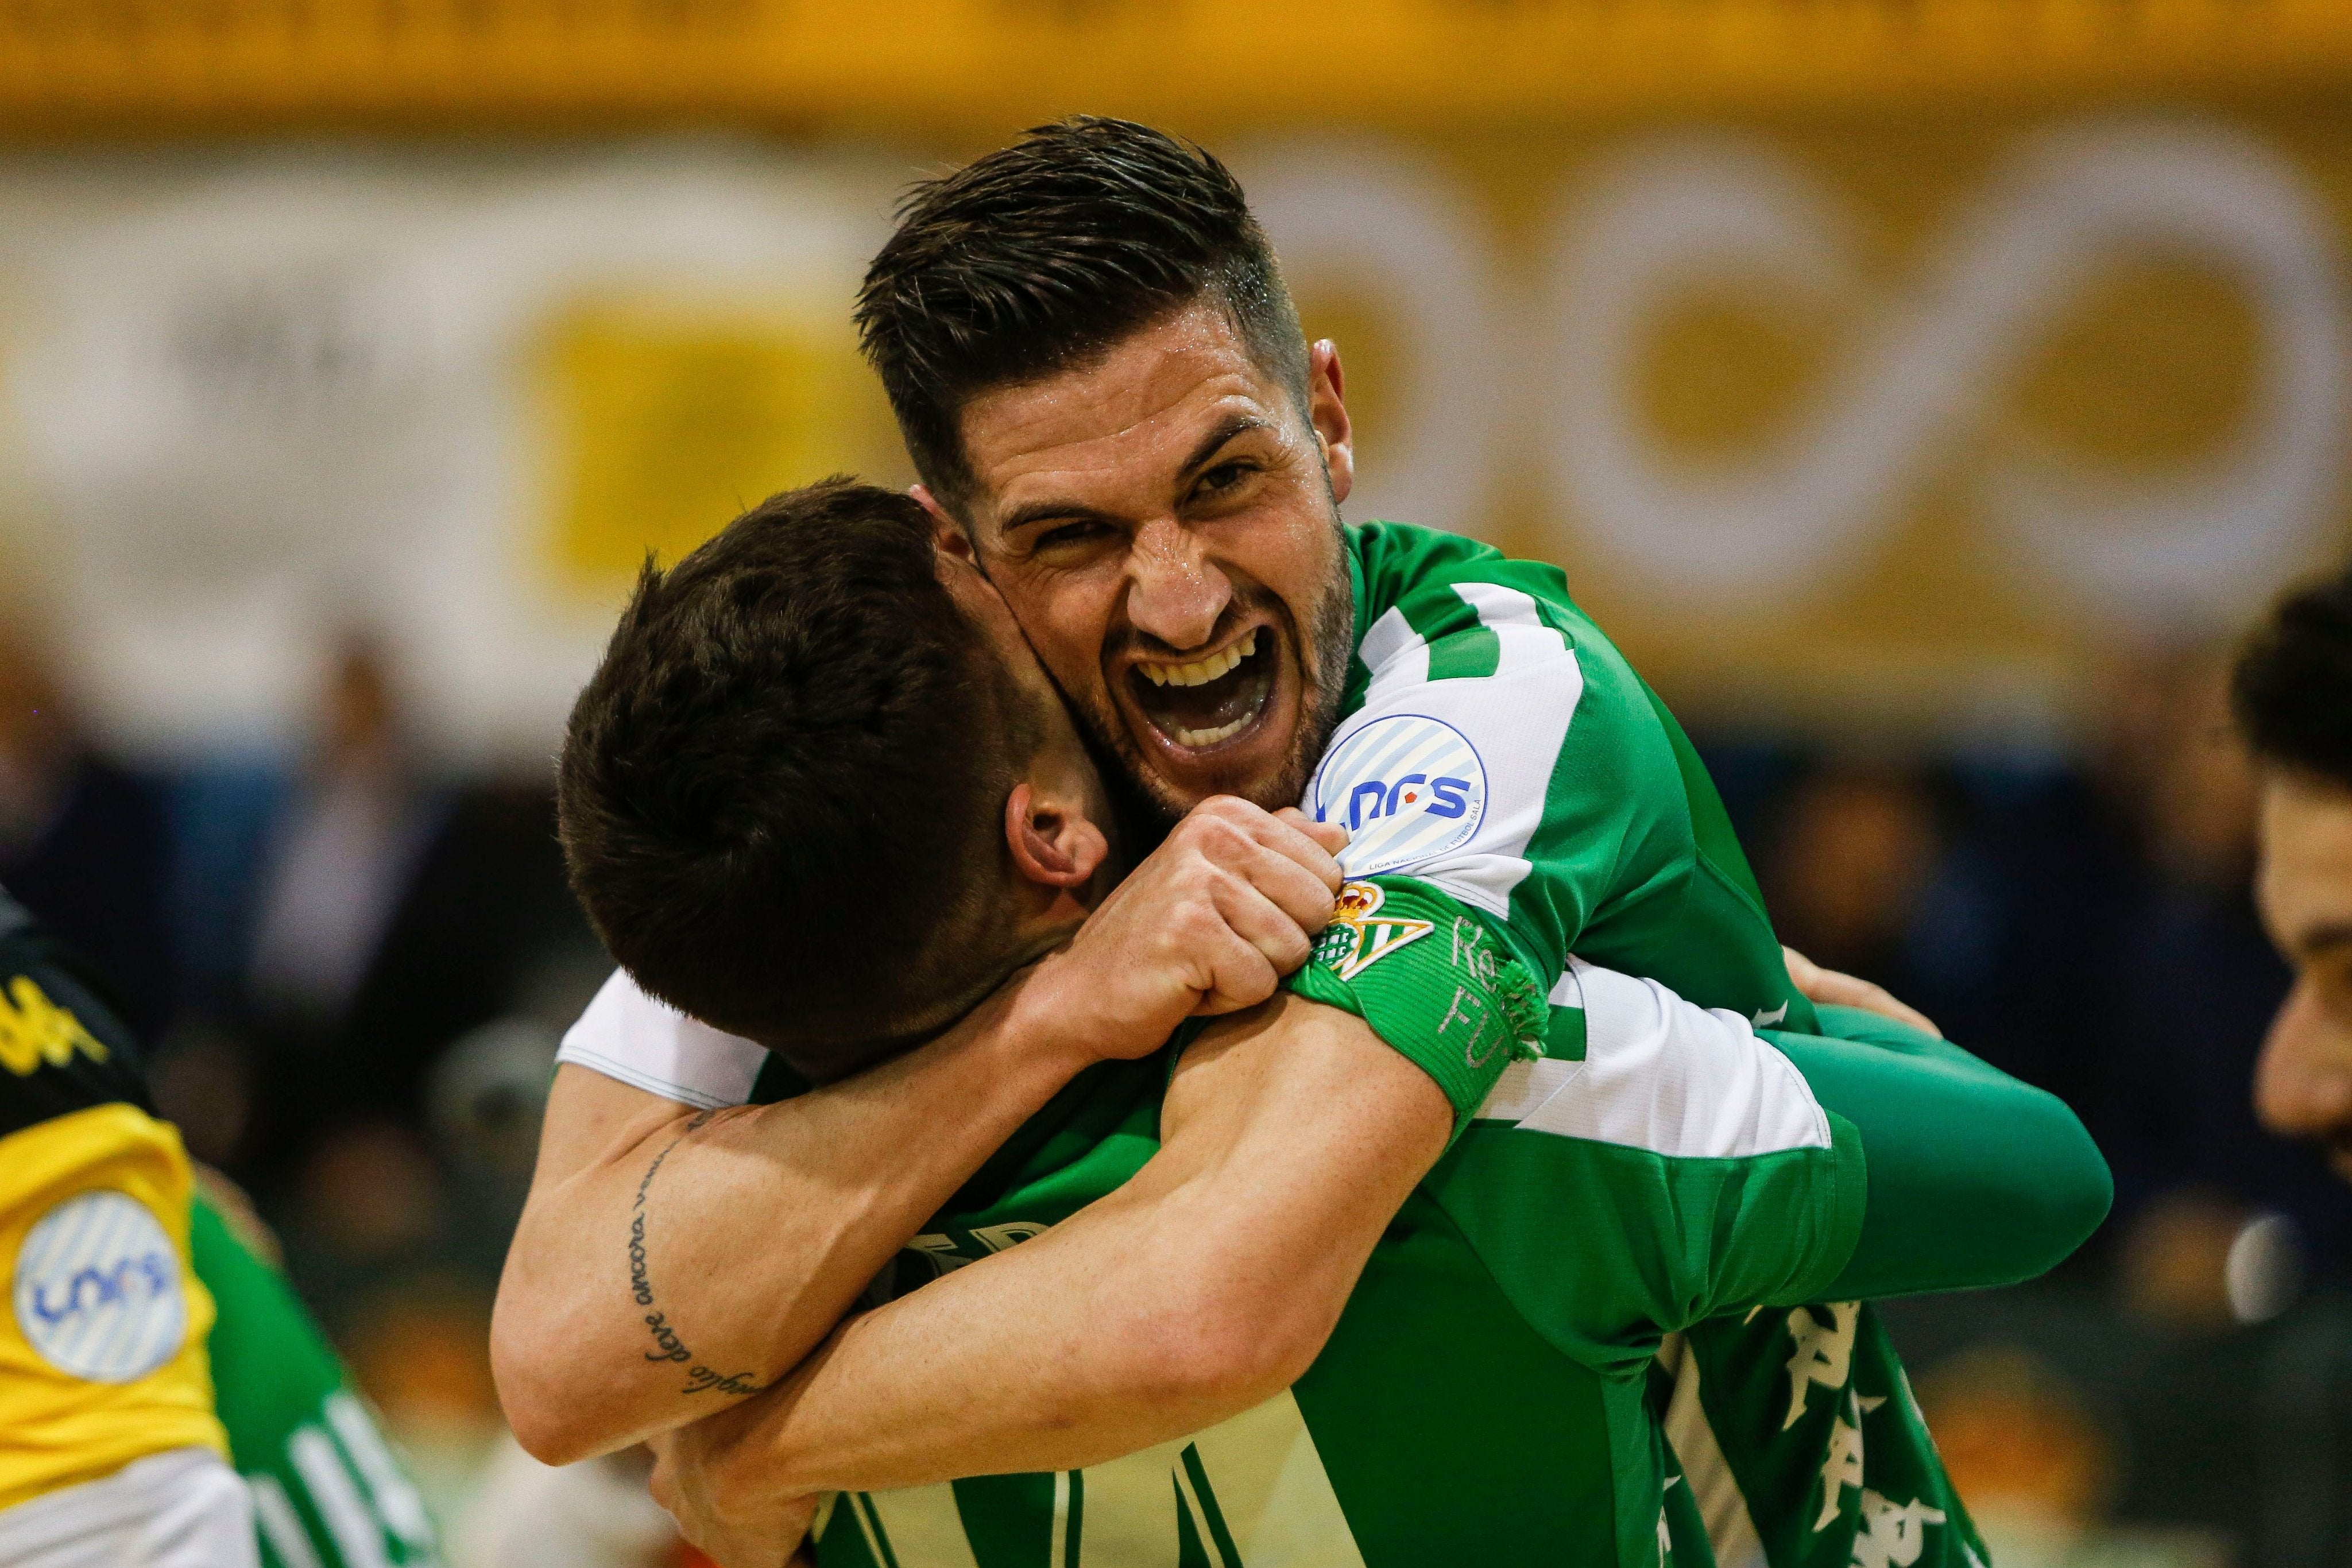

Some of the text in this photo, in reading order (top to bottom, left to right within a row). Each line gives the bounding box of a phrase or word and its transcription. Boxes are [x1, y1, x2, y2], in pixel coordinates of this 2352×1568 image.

[1370, 861, 1391, 870] LIGA
[1393, 851, 1437, 865] NACIONAL
[1470, 799, 1481, 820] SALA
[629, 1211, 653, 1306] ancora
[645, 1312, 691, 1362] deve
